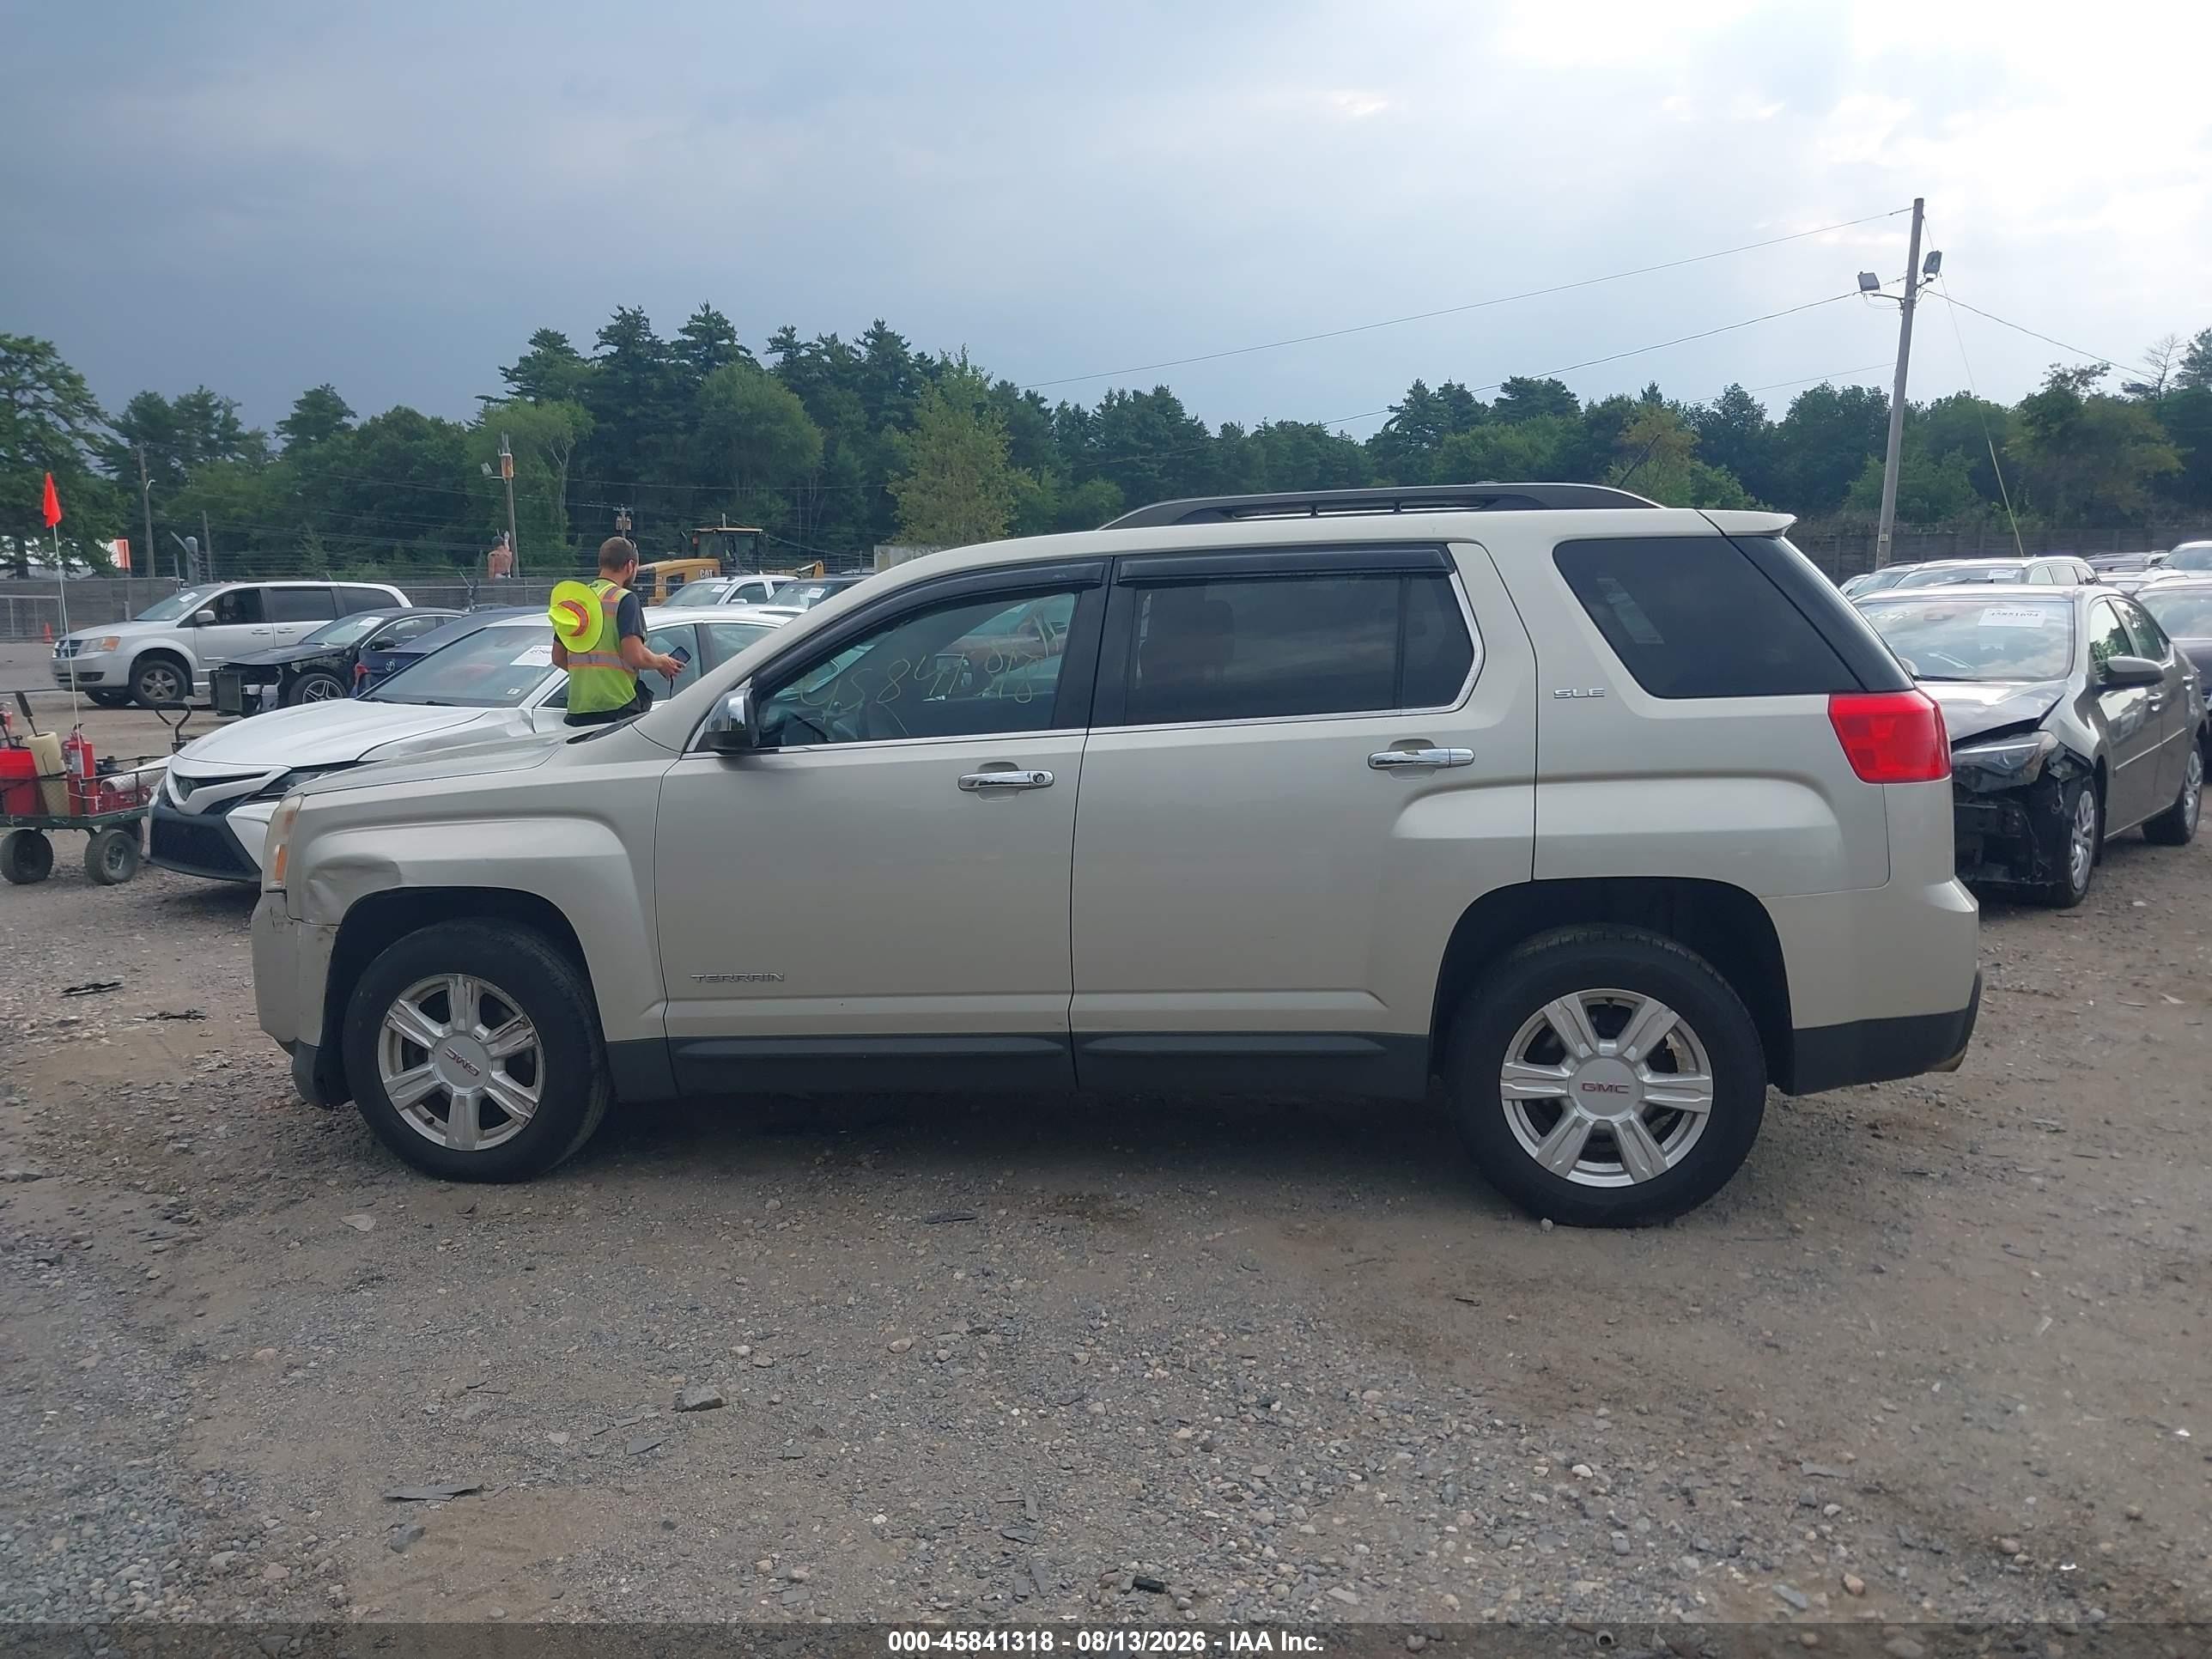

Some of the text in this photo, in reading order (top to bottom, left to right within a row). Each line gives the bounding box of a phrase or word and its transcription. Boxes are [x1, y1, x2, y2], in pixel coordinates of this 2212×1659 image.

[699, 568, 714, 579] CAT
[1553, 688, 1605, 699] SLE
[690, 972, 785, 984] TERRAIN
[444, 1044, 482, 1078] GMC
[1580, 1080, 1630, 1094] GMC
